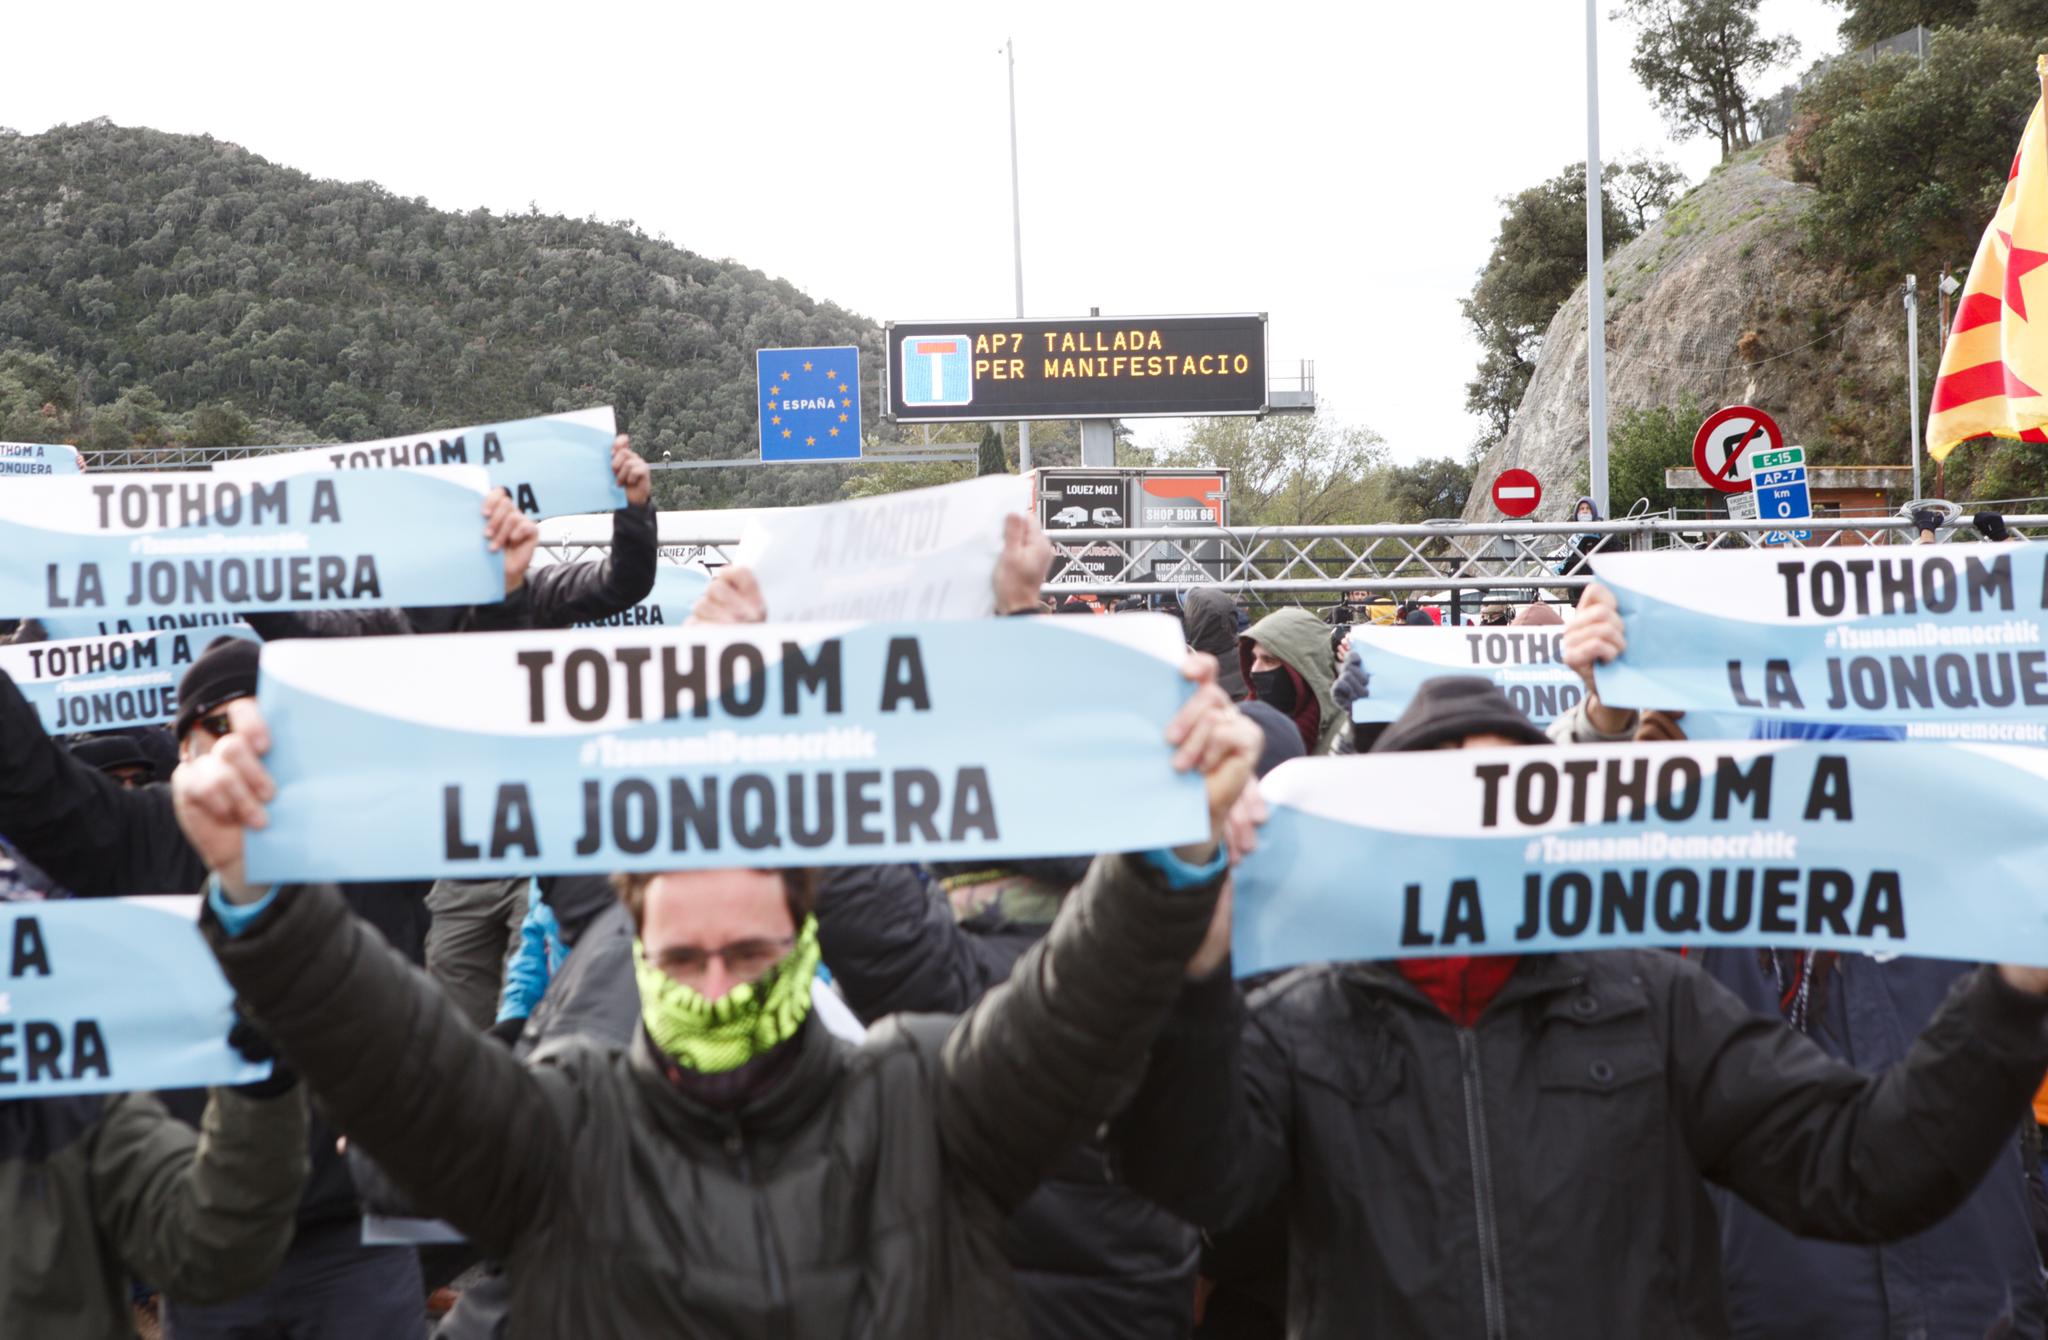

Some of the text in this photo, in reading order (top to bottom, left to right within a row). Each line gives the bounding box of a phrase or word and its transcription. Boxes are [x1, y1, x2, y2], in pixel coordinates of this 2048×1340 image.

[975, 330, 1162, 354] AP7 TALLADA
[975, 354, 1249, 380] PER MANIFESTACIO
[782, 397, 836, 411] ESPAÑA
[36, 446, 45, 457] A
[483, 431, 505, 465] A
[1763, 451, 1792, 466] E-15
[1066, 485, 1093, 495] LOUEZ
[1095, 485, 1113, 495] MOI
[1763, 470, 1797, 485] AP-7
[1773, 489, 1790, 499] km
[92, 479, 341, 529] TOTHOM A
[1146, 509, 1173, 521] SHOP
[1176, 509, 1197, 521] BOX
[1777, 501, 1791, 518] 0
[47, 554, 382, 608] LA JONQUERA
[1777, 553, 2015, 618] TOTHOM
[29, 634, 193, 678] TOTHOM A
[517, 636, 933, 725] TOTHOM A
[1727, 651, 2048, 711] LA JONQUE
[1475, 755, 1854, 827] TOTHOM A
[443, 766, 1000, 862] LA JONQUERA
[1400, 867, 1907, 947] LA JONQUERA
[10, 916, 52, 978] A
[0, 1018, 111, 1084] ERA
